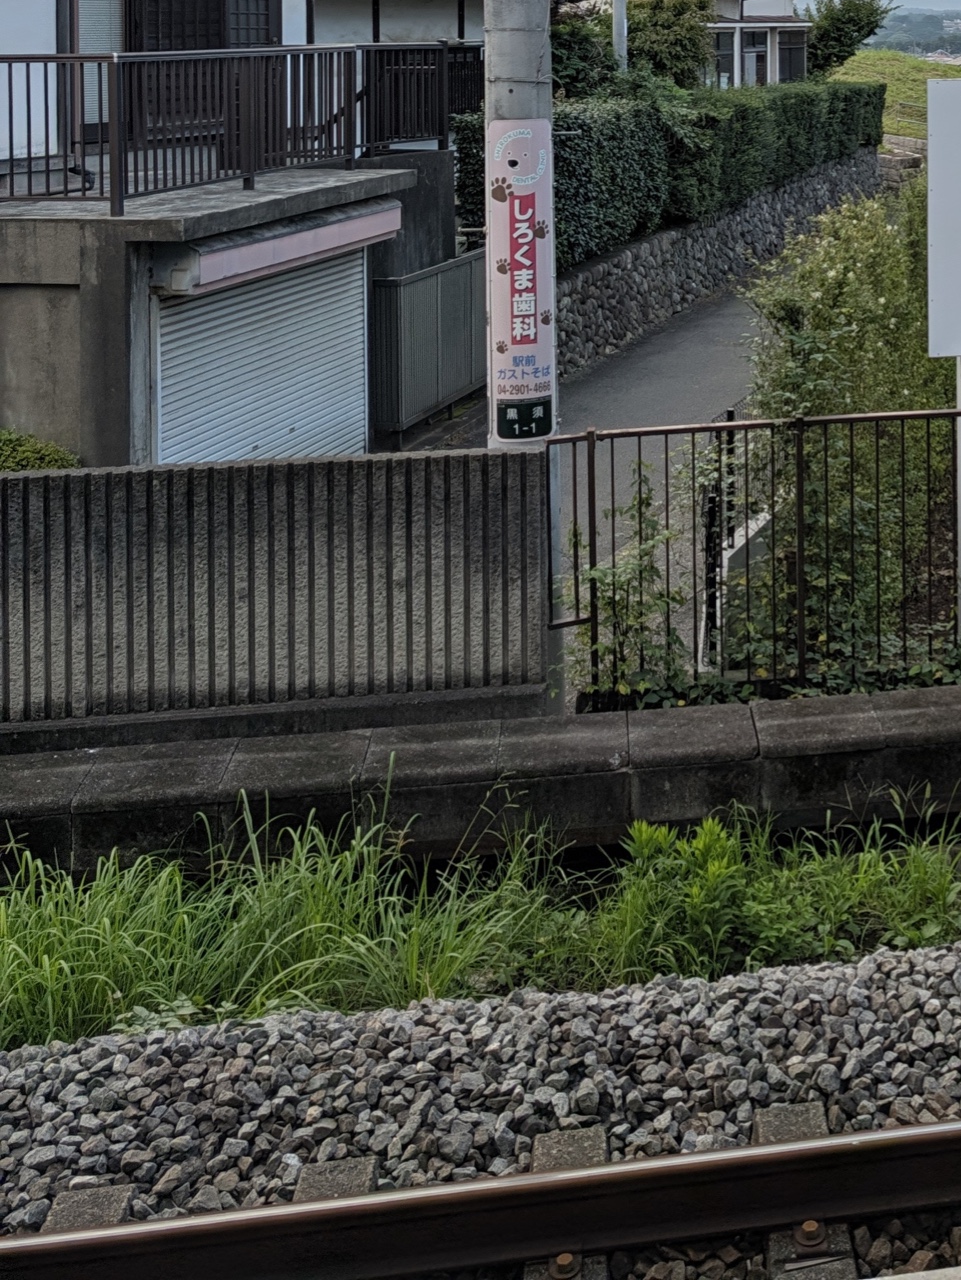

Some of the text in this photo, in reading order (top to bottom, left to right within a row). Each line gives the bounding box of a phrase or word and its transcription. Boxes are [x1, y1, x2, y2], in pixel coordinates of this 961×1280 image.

[494, 128, 532, 160] SHIROKUMA
[511, 174, 539, 185] DENTAL
[512, 199, 537, 341] しろくま歯科
[512, 355, 536, 368] 駅前
[497, 365, 551, 380] ガストそば
[506, 405, 544, 420] 黒須
[512, 422, 536, 435] 1-1
